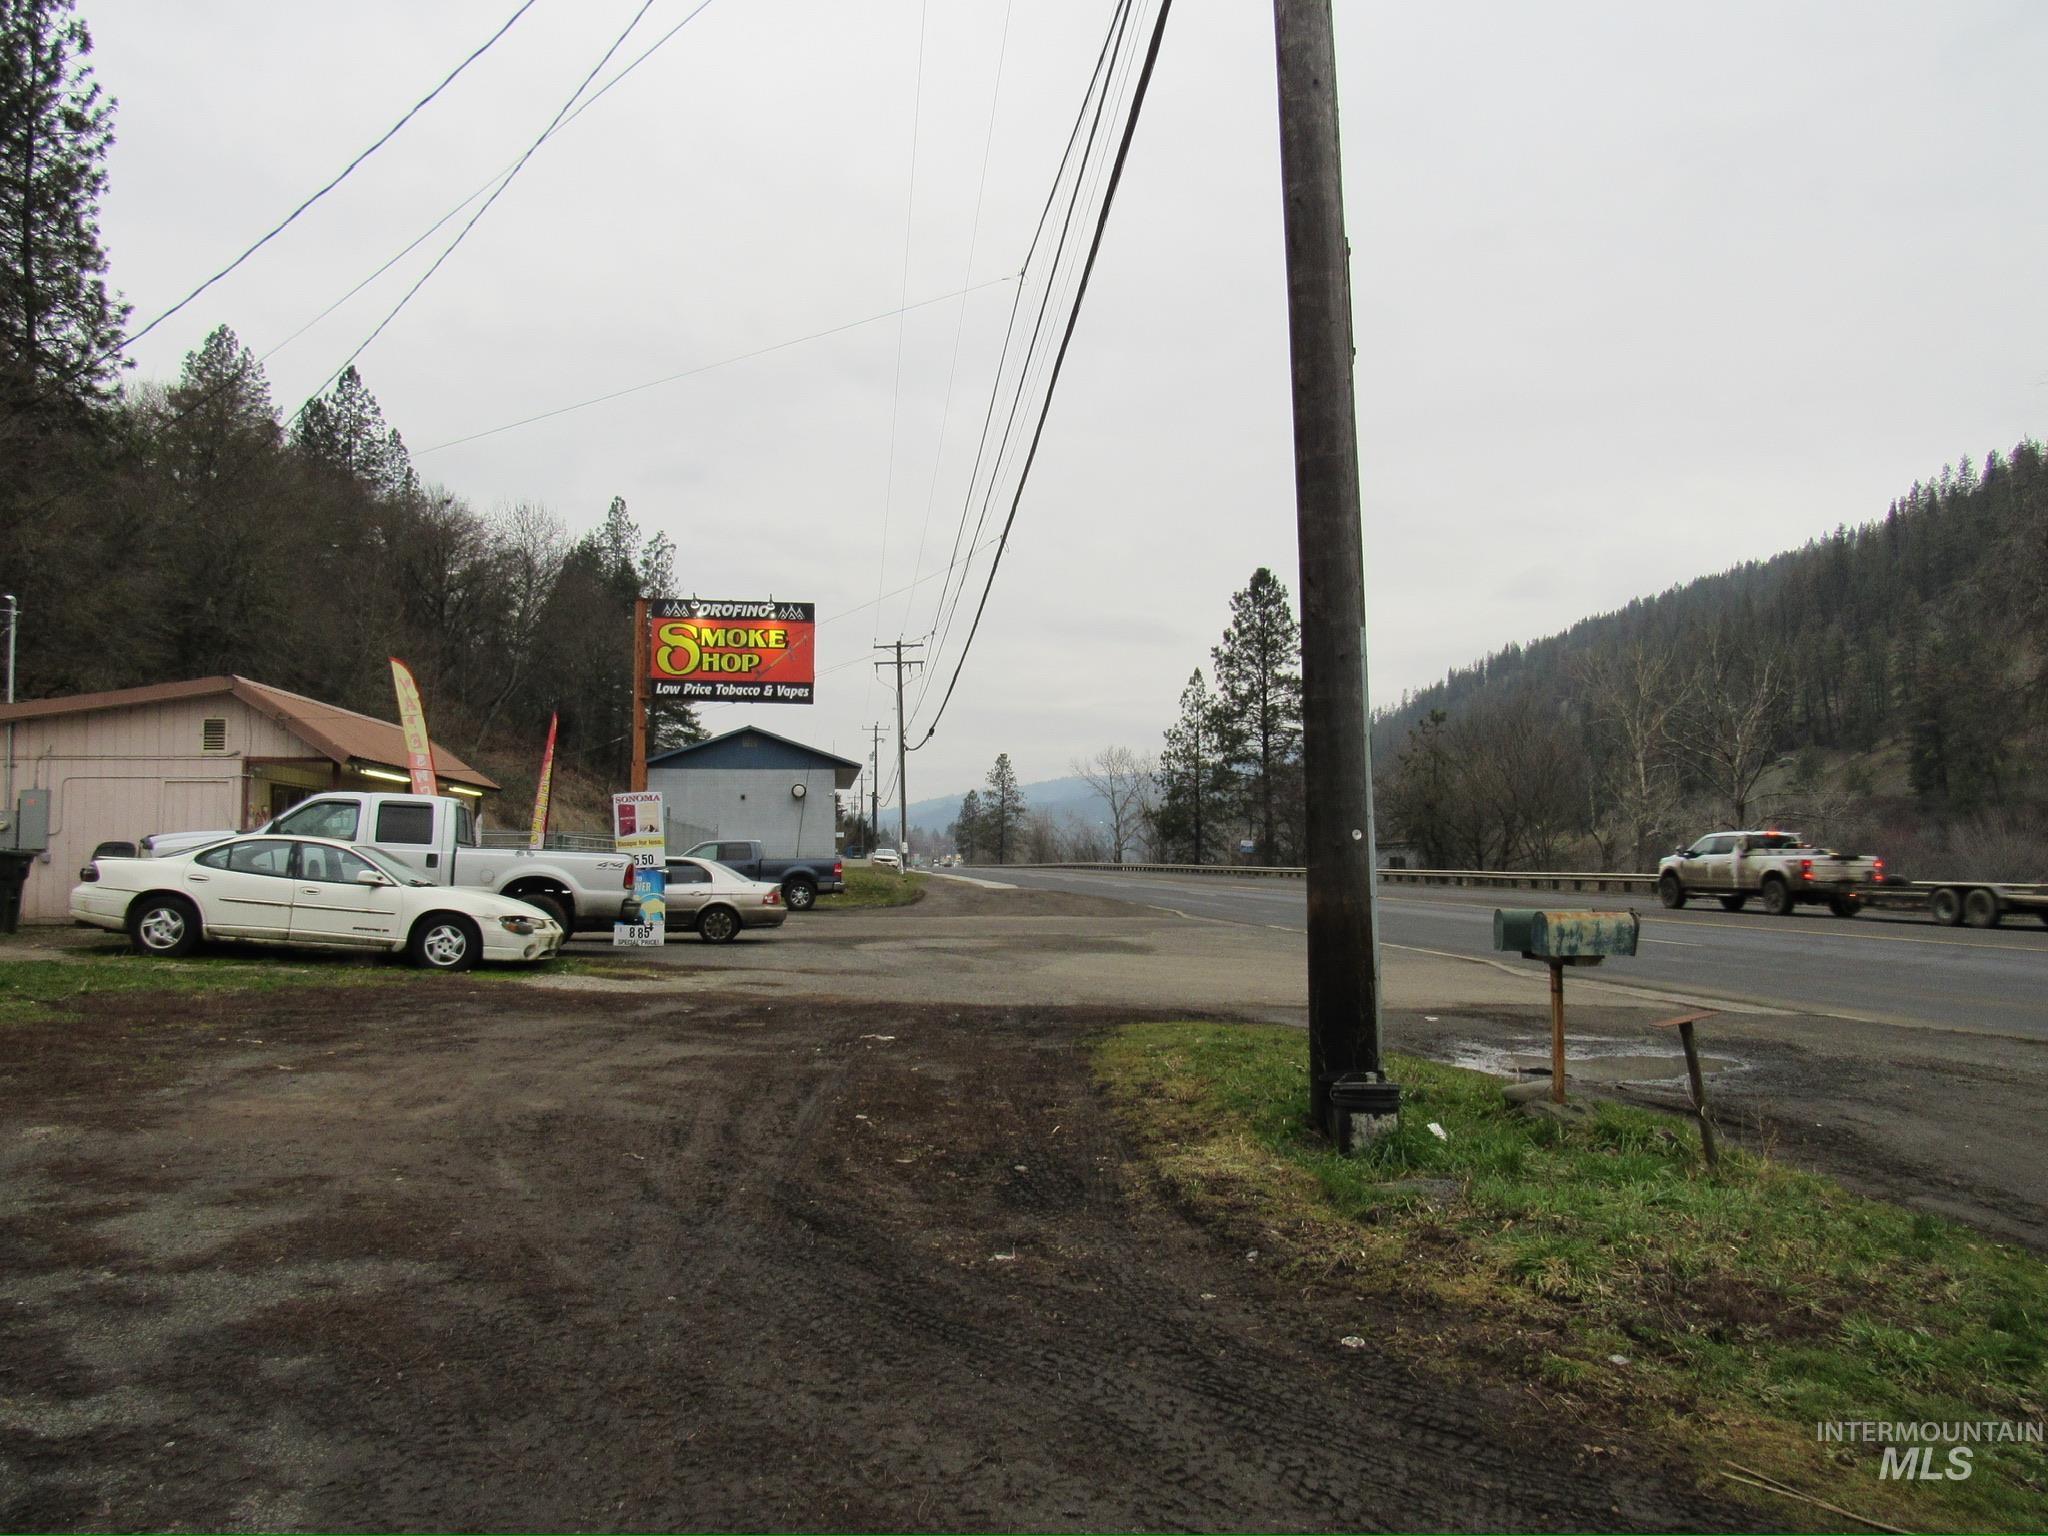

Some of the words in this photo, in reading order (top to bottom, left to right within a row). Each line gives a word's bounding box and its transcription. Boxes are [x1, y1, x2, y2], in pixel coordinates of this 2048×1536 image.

[700, 603, 769, 617] OROFINO
[656, 683, 681, 695] Low
[683, 683, 711, 696] Price
[716, 684, 761, 697] Tobacco
[763, 685, 773, 696] &
[777, 685, 810, 699] Vapes
[615, 794, 661, 804] SONOMA
